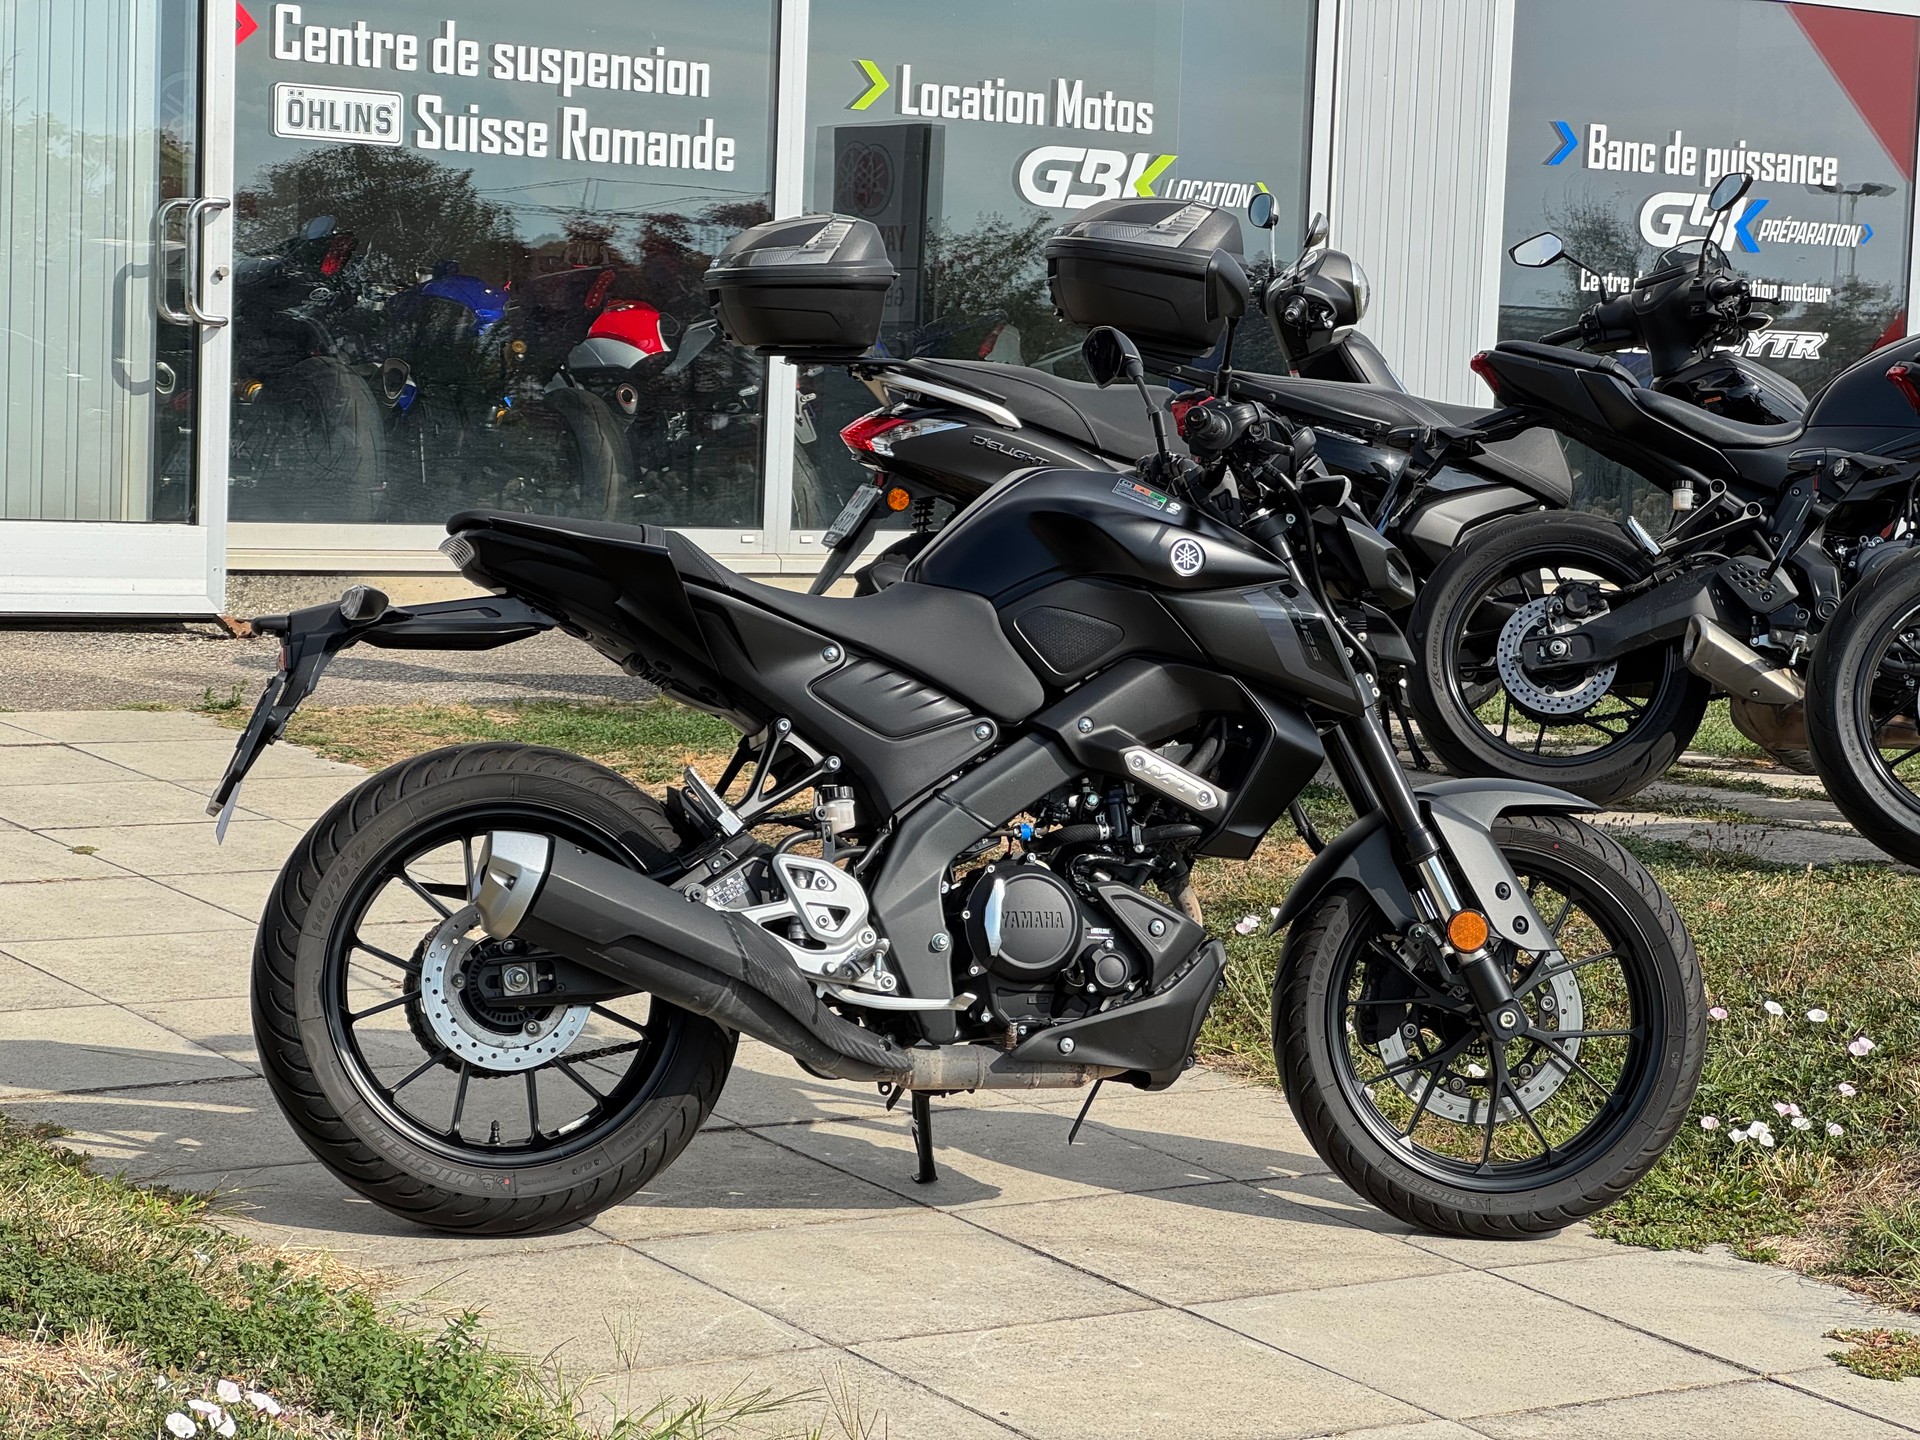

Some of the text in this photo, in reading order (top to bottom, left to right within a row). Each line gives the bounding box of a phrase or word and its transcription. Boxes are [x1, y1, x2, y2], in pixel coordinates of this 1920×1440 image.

[275, 3, 710, 97] Centre de suspension
[286, 89, 392, 135] ÖHLINS
[901, 64, 1153, 134] Location Motos
[417, 94, 735, 172] Suisse Romande
[1588, 123, 1838, 186] Banc de puissance
[1165, 179, 1255, 208] LOCATION
[1758, 217, 1862, 247] PRÉPARATION
[1781, 283, 1831, 303] moteur
[1001, 911, 1065, 928] YAMAHA
[352, 1114, 476, 1187] MICHELIN
[1385, 1164, 1467, 1205] MICHELIN
